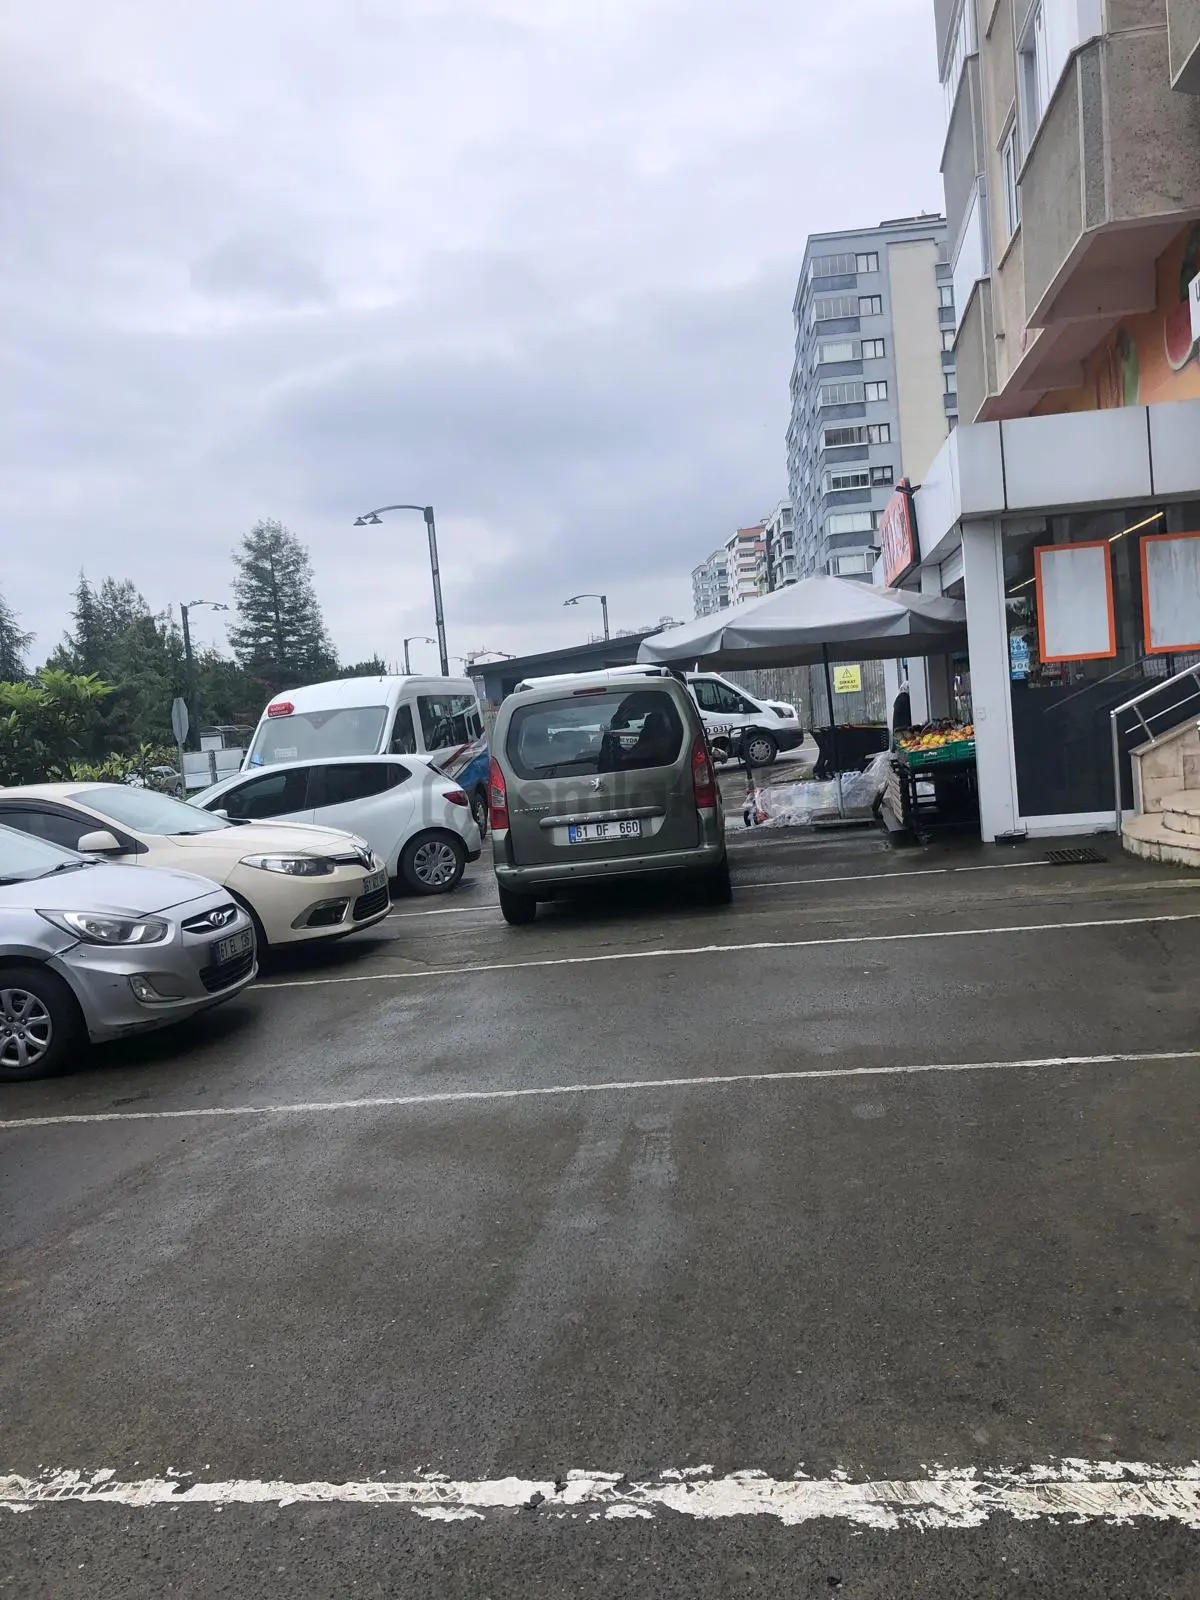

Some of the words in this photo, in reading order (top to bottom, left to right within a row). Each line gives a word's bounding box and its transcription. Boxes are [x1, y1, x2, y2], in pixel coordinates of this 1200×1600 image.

[576, 826, 588, 838] 61
[596, 824, 609, 836] DF
[619, 821, 638, 833] 660
